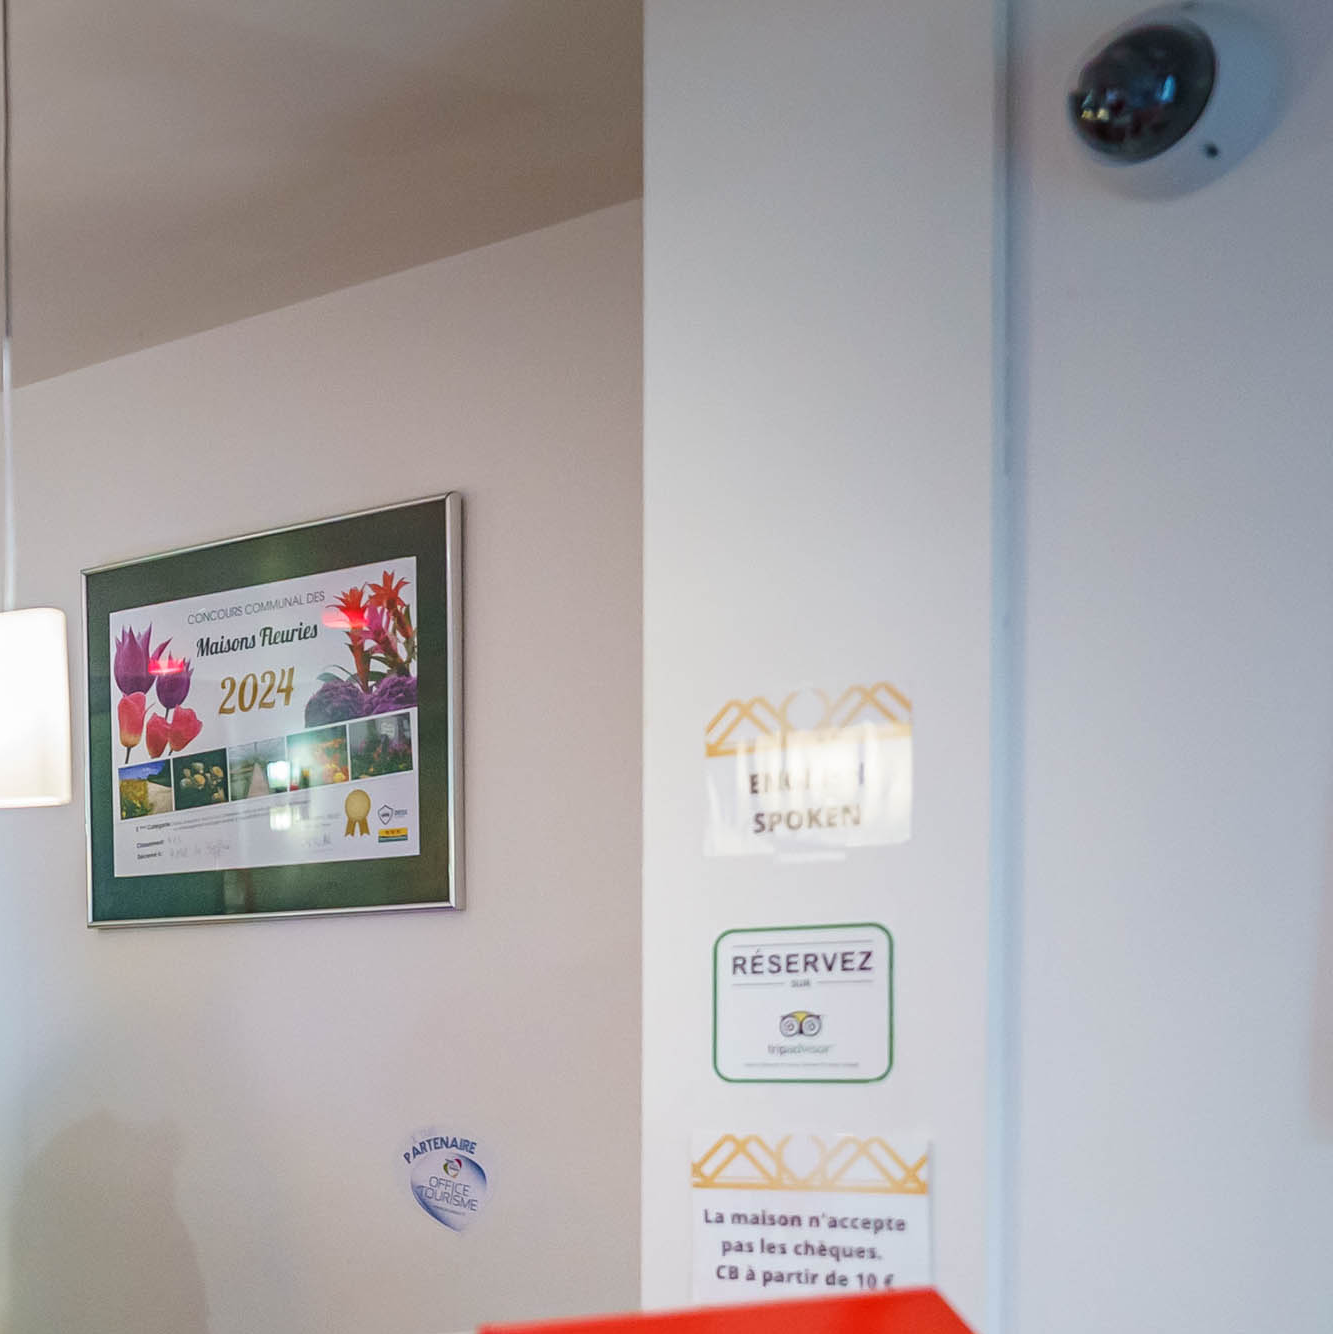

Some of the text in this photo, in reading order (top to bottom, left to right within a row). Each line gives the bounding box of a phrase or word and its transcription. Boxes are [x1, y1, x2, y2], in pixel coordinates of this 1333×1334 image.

[187, 591, 326, 625] CONCOURS COMMUNAL DES
[196, 622, 318, 658] Maisons Fleuries
[218, 666, 295, 715] 2024
[753, 803, 861, 834] SPOKEN
[732, 948, 874, 976] RÉSERVEZ
[403, 1136, 478, 1165] PARTENAIRE
[416, 1185, 478, 1212] TOURISME
[428, 1176, 471, 1198] OFFICE
[703, 1209, 907, 1234] La maison n'accepte
[721, 1238, 882, 1262] pas les chèques.
[716, 1264, 739, 1280] CB
[745, 1265, 756, 1282] à
[762, 1267, 819, 1287] partir
[825, 1269, 849, 1287] de
[857, 1272, 877, 1290] 10
